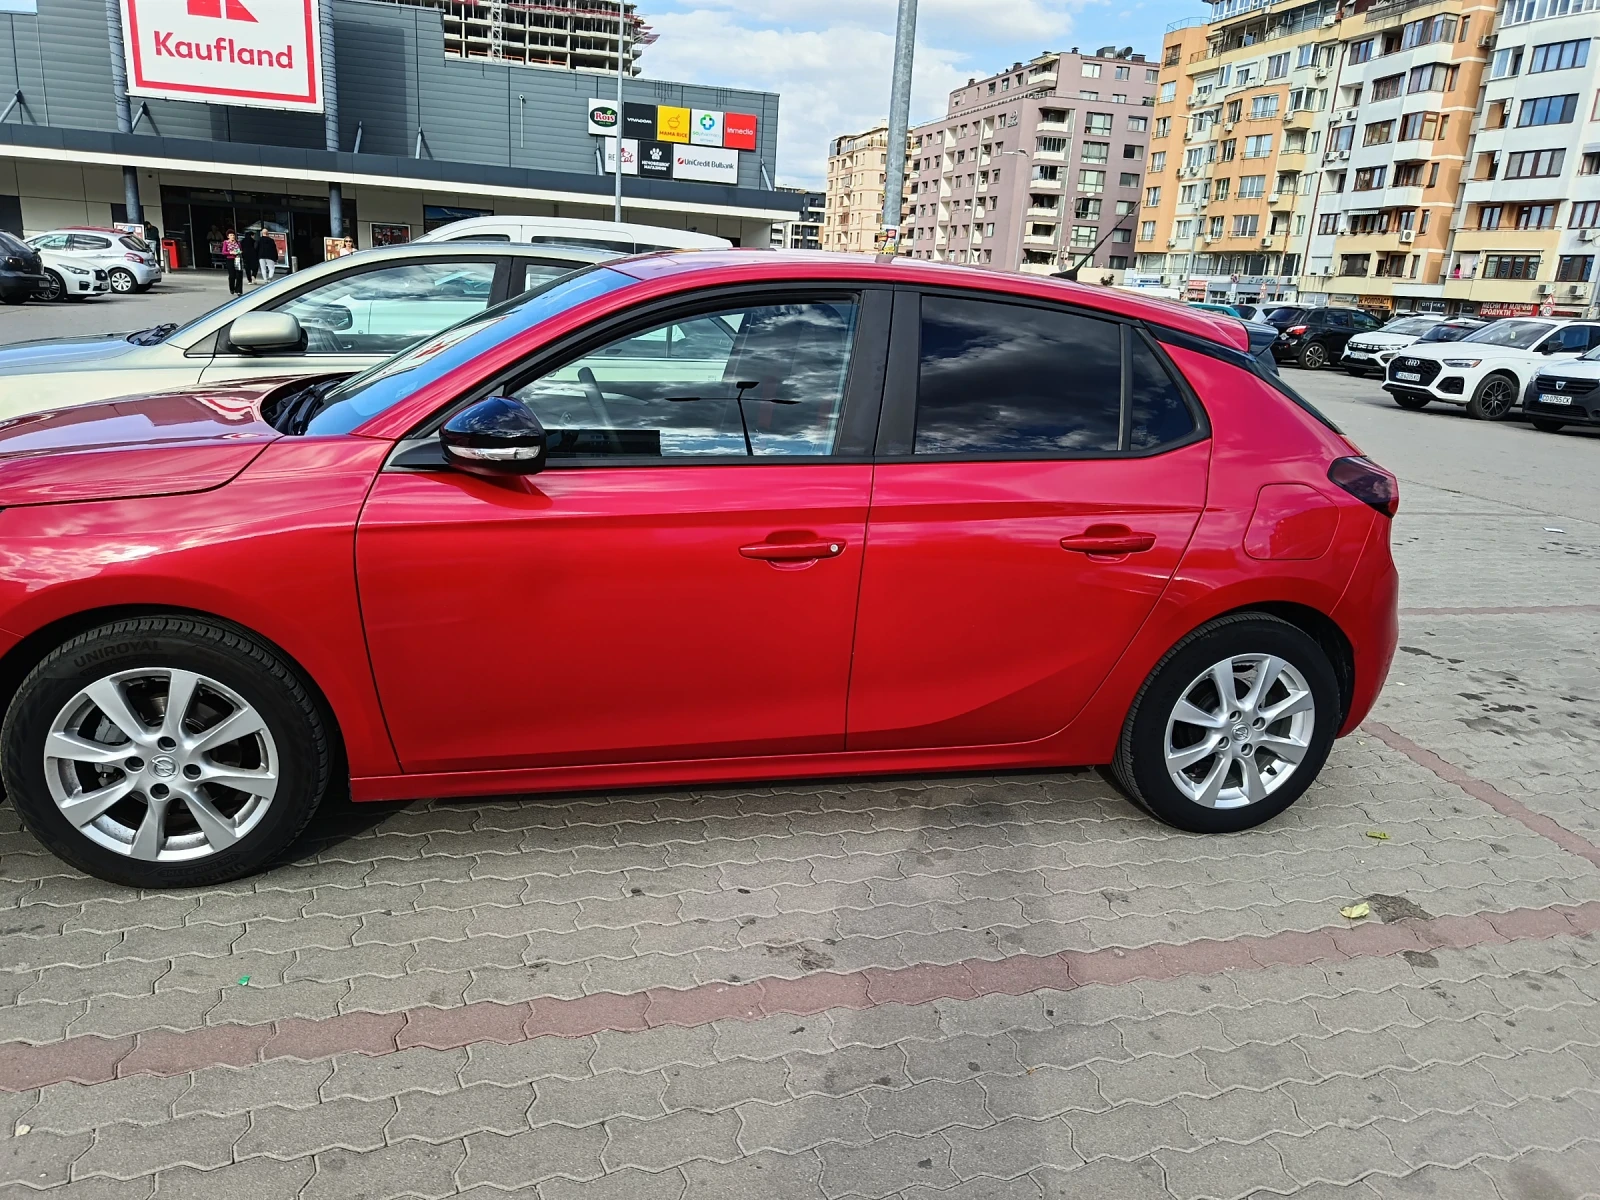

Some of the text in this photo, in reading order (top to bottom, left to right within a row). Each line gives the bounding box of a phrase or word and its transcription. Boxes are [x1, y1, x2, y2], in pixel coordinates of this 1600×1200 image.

[154, 30, 294, 69] Kaufland
[659, 130, 676, 138] MAMA
[684, 159, 735, 170] UniCredit Bulbank
[1509, 303, 1534, 311] МЛЕЧНИ
[1480, 308, 1511, 316] ПРОДУКТИ
[73, 640, 163, 668] UNIROYAL
